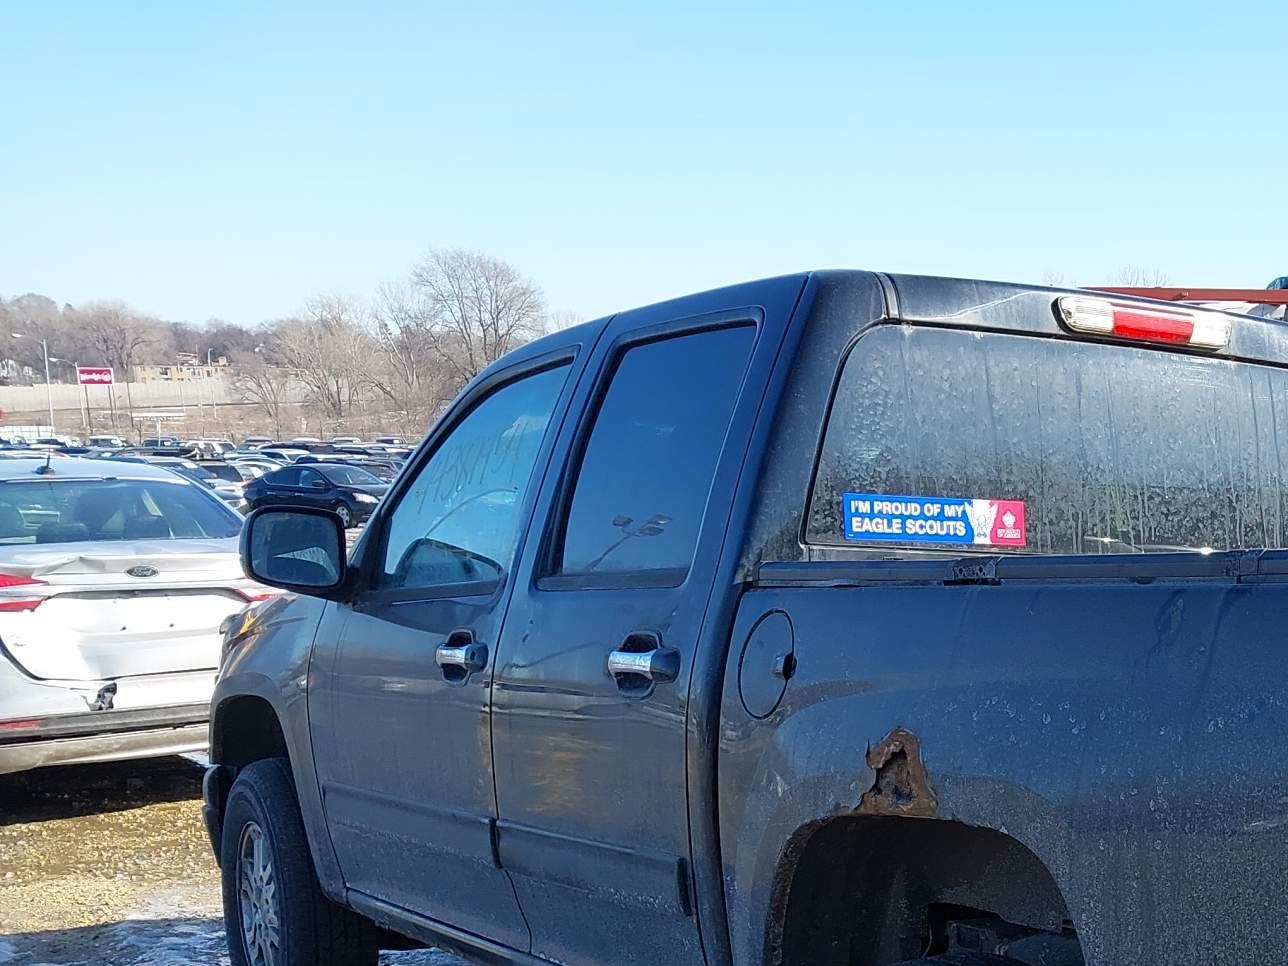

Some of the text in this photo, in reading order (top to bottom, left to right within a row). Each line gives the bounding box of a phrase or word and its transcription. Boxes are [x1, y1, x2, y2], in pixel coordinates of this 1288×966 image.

[850, 500, 964, 517] I'M PROUD OF MY
[851, 517, 966, 536] EAGLE SCOUTS
